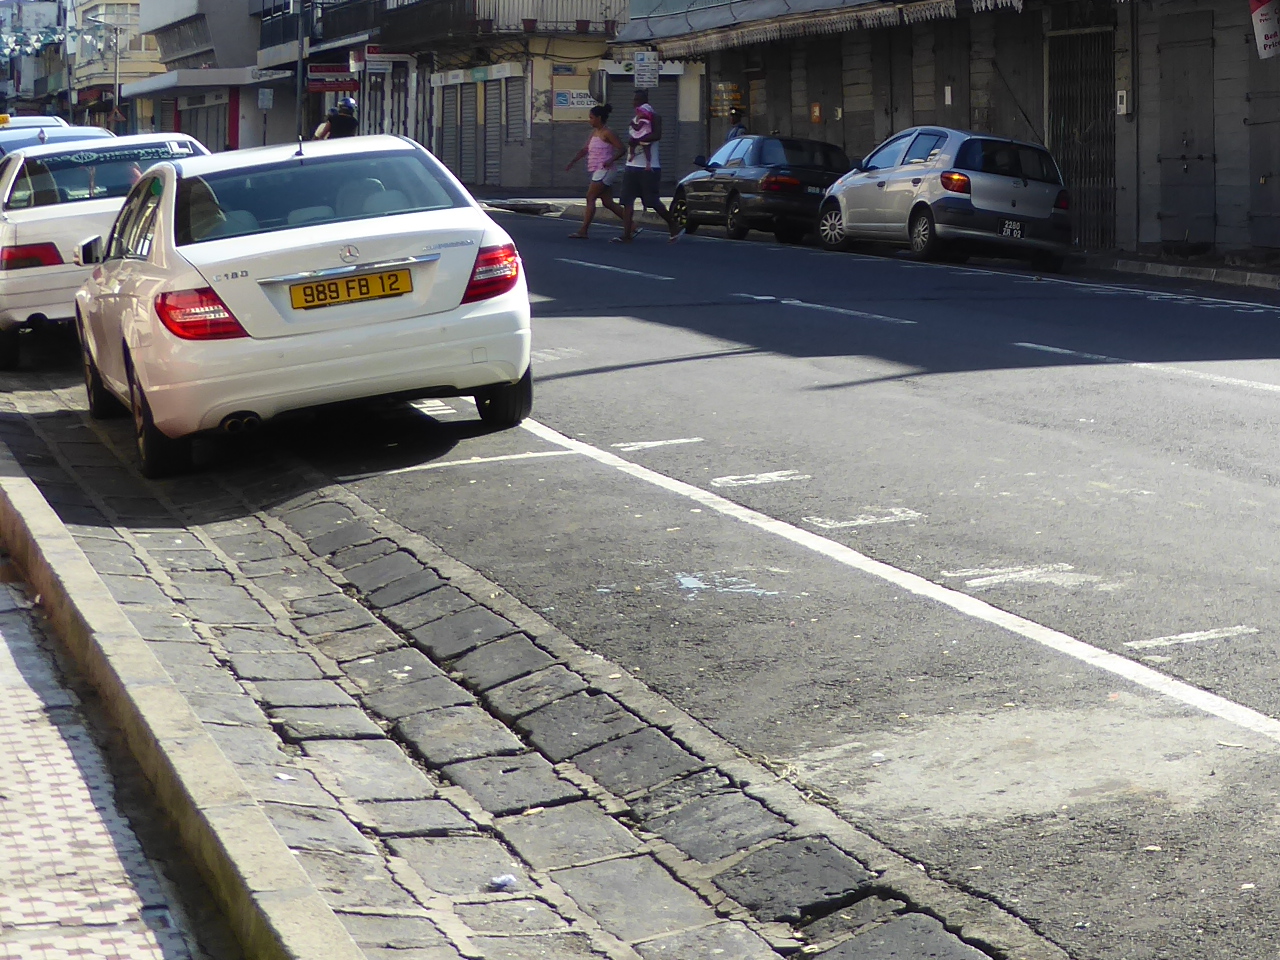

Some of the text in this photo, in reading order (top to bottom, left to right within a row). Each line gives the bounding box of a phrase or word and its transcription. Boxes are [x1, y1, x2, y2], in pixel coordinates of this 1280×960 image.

[303, 274, 401, 305] 989 FB 12
